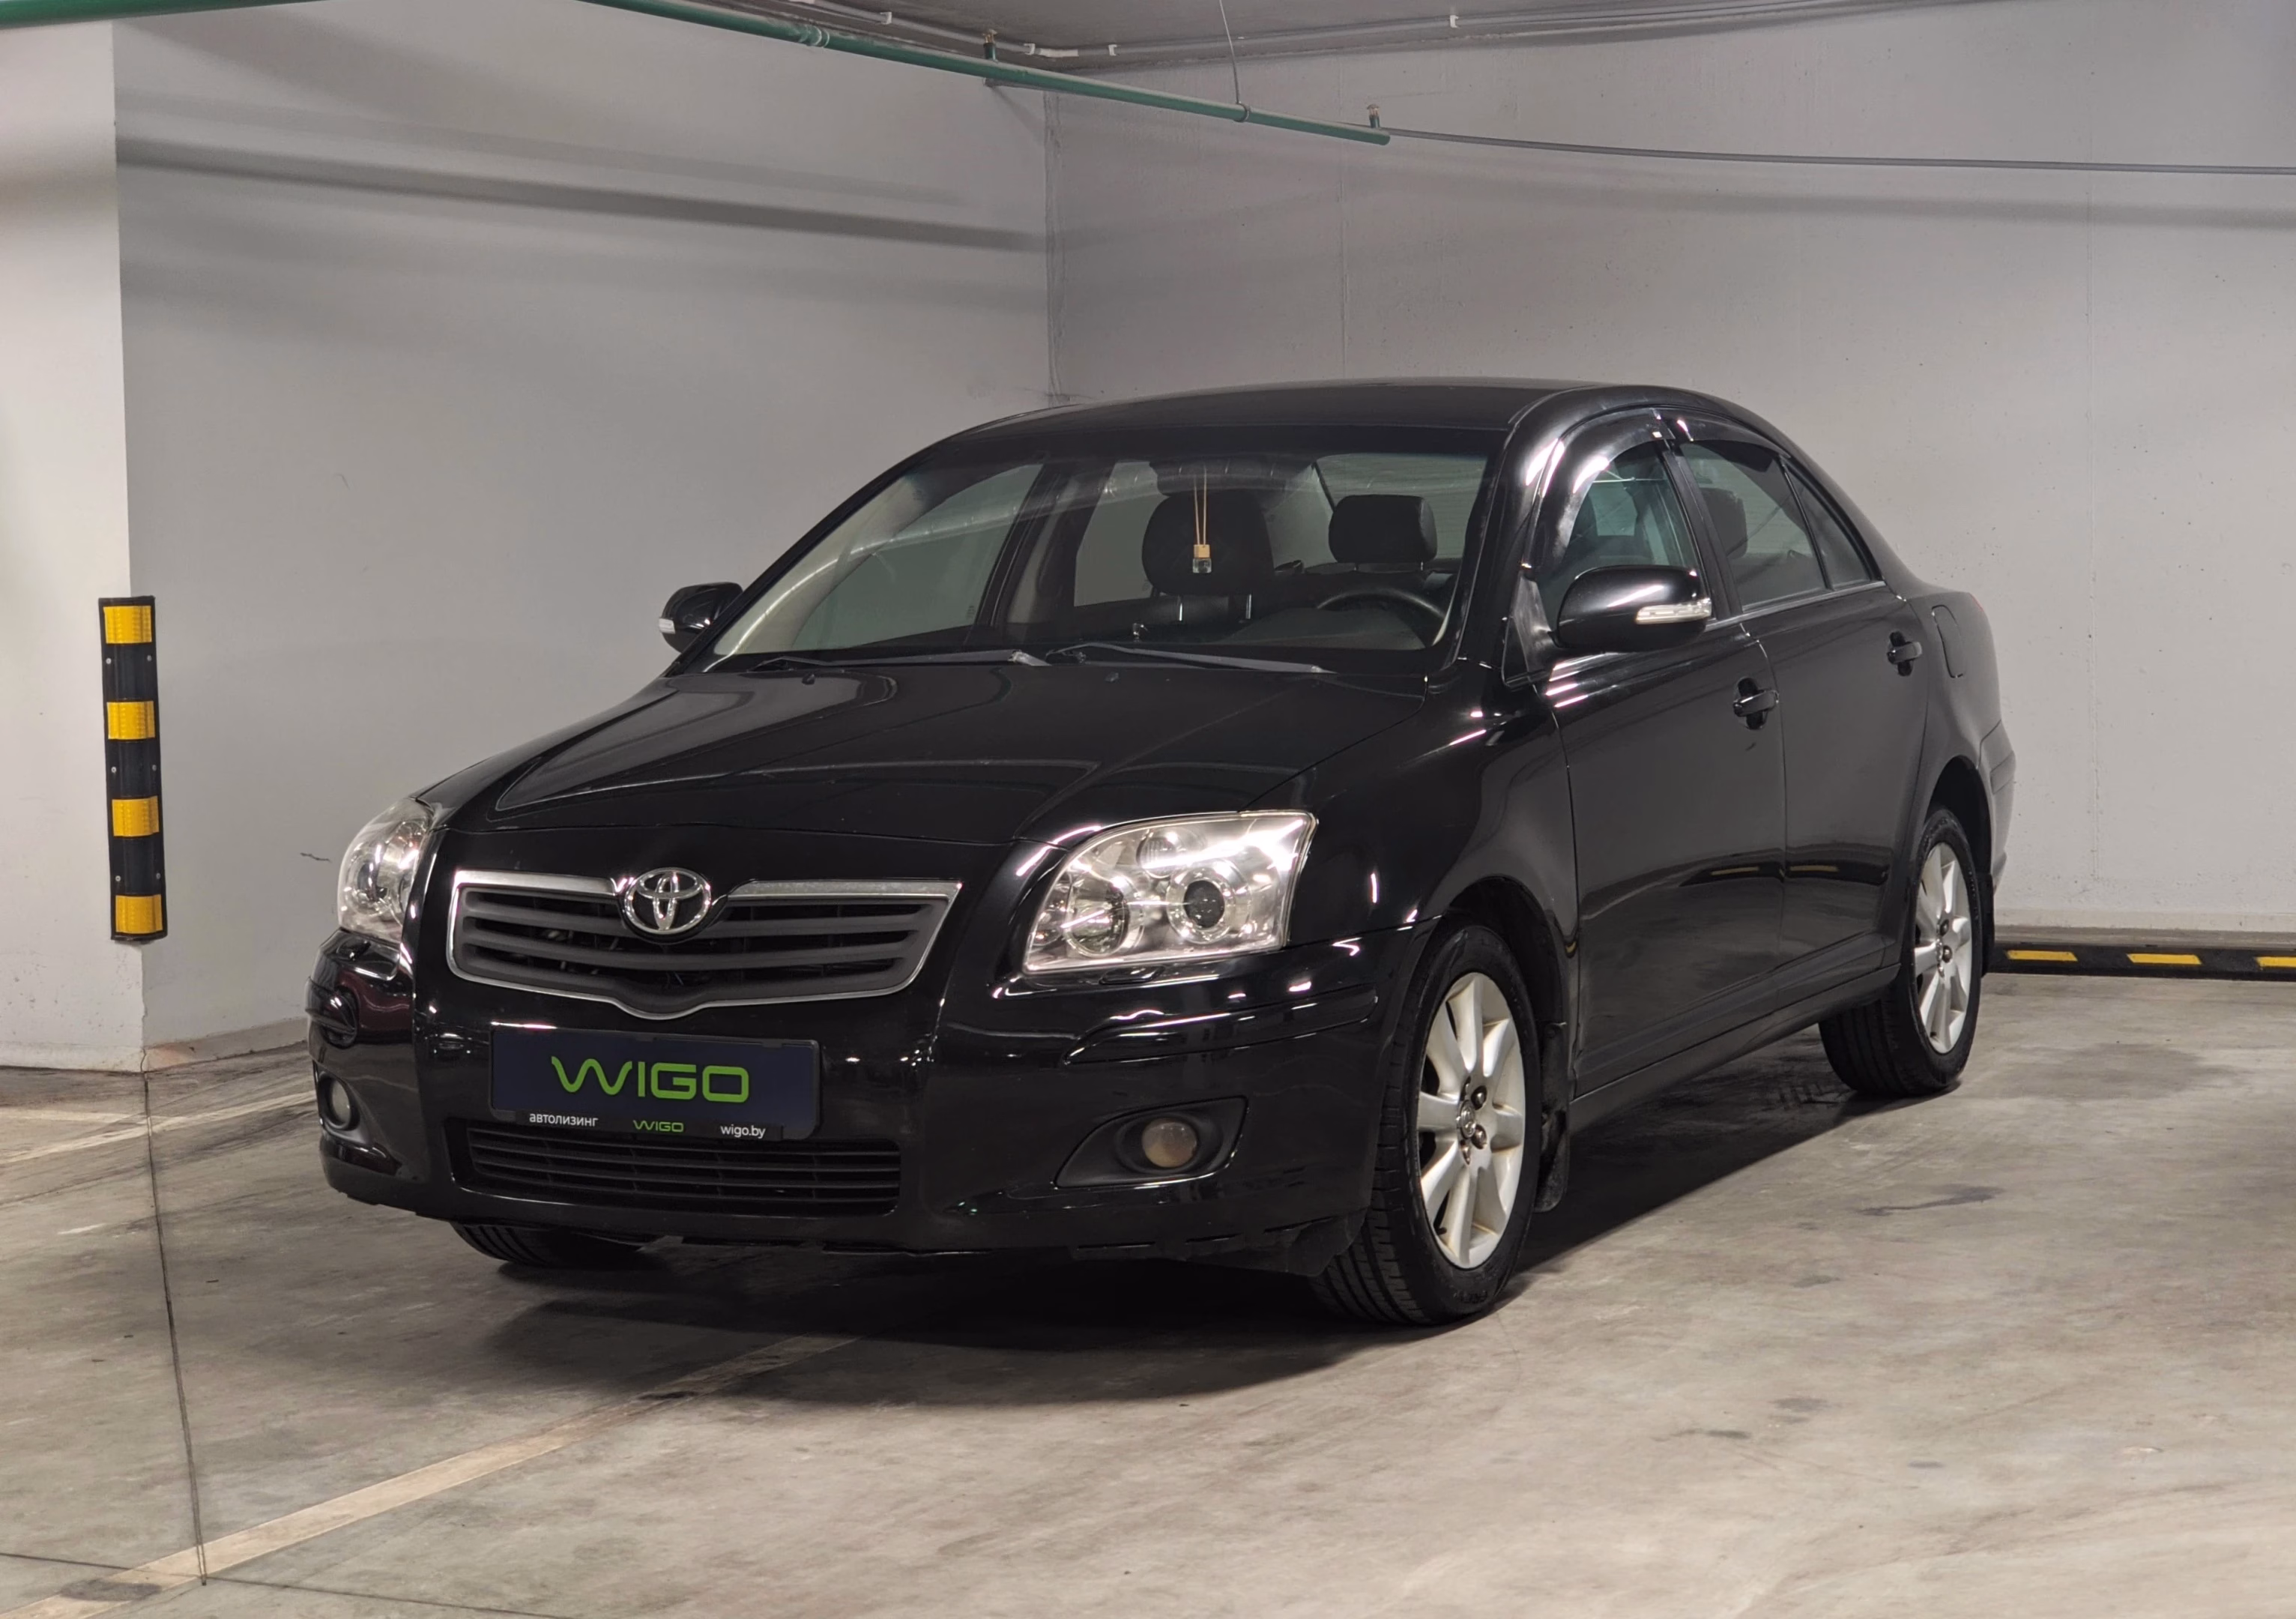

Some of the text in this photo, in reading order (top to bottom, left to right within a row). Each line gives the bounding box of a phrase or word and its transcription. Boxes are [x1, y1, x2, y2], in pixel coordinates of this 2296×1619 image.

[551, 1056, 749, 1103] WIGO
[528, 1112, 598, 1127] автолизинг
[633, 1120, 684, 1133] WIGO
[720, 1124, 766, 1139] wigo.by
